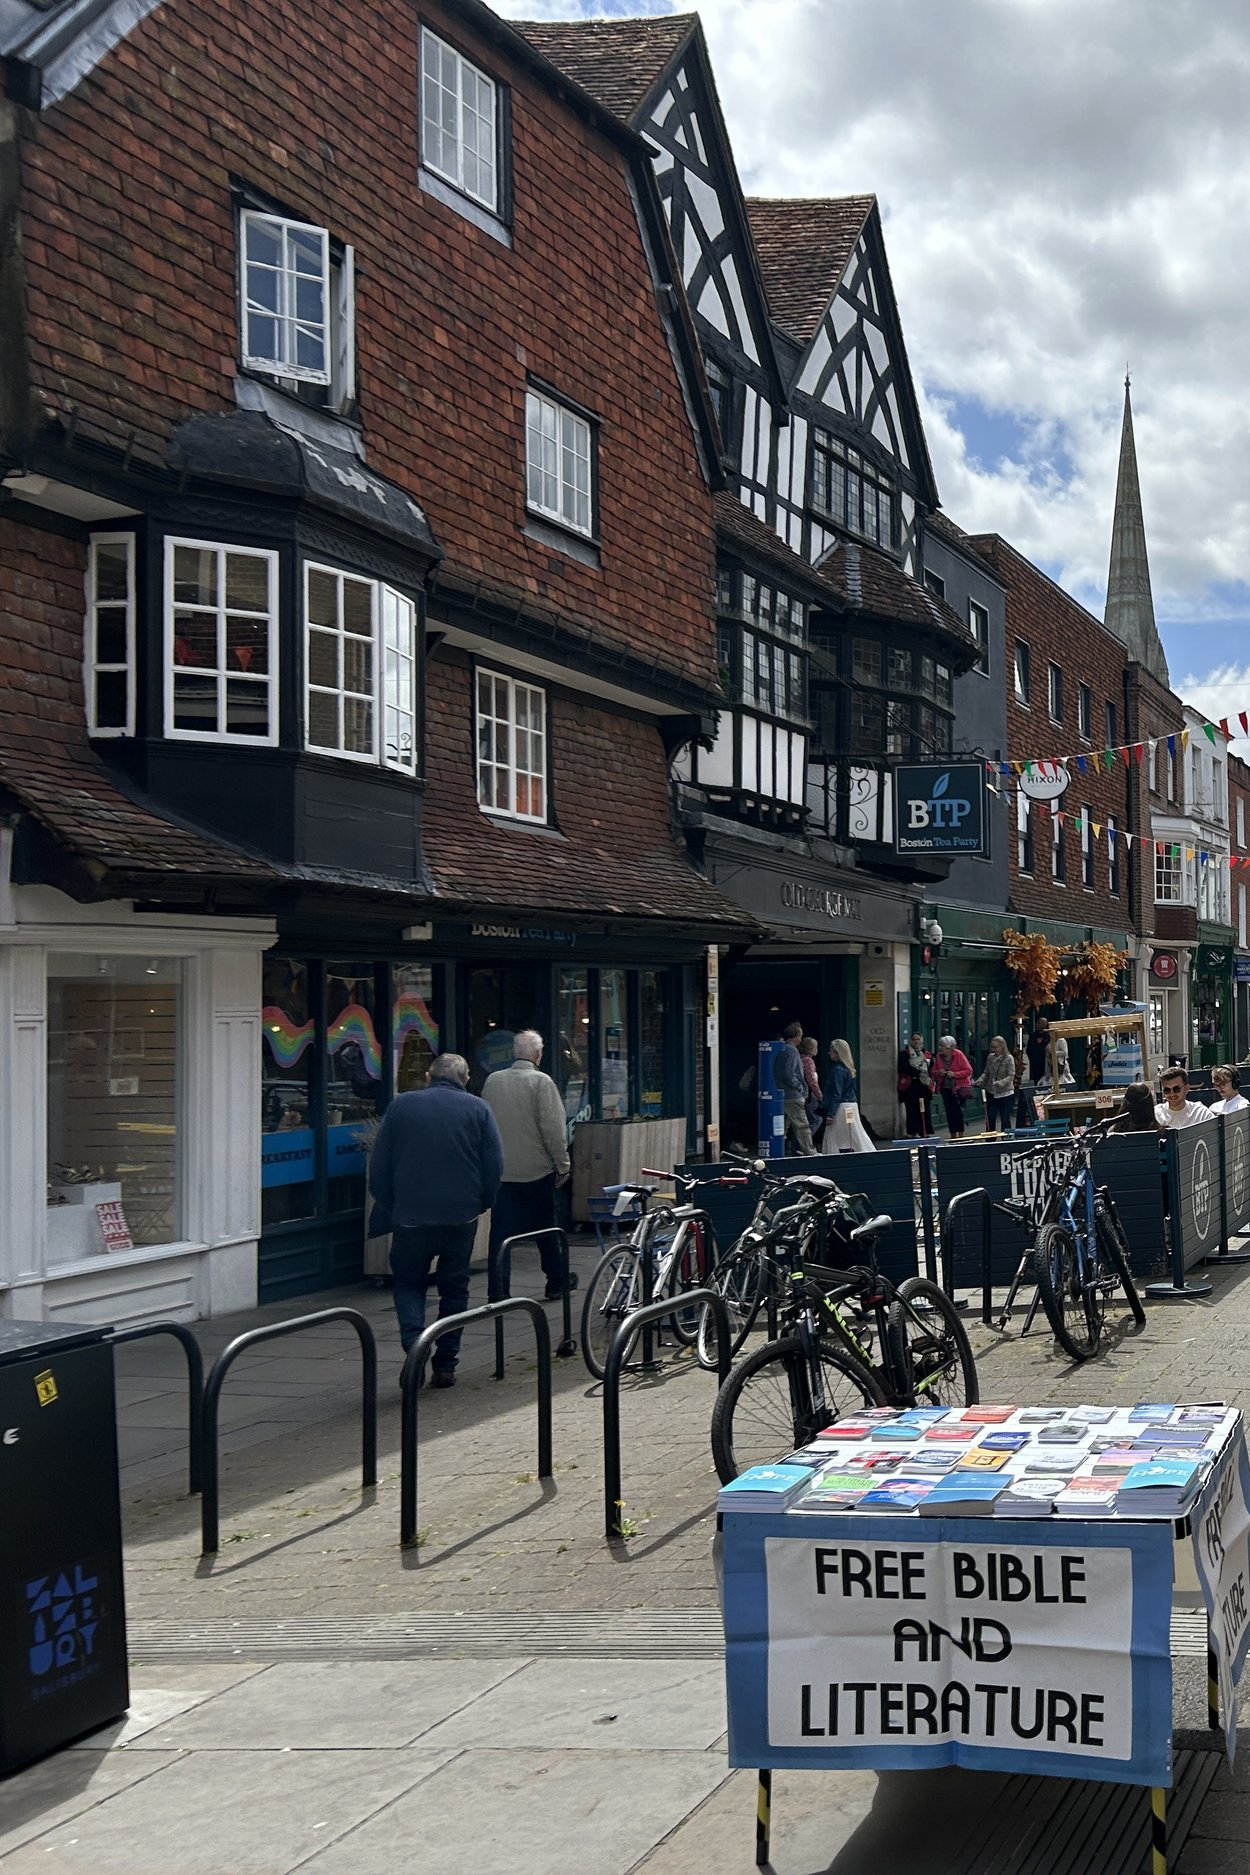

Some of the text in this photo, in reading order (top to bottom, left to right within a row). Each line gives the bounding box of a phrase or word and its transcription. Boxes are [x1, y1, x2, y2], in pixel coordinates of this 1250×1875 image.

[907, 798, 972, 829] BTP
[900, 836, 979, 848] Boston Tea Party
[1097, 1096, 1112, 1104] 306
[96, 1202, 123, 1214] SALE
[98, 1212, 125, 1224] SALE
[101, 1222, 130, 1235] SALE
[1131, 1466, 1188, 1479] HOPE
[814, 1547, 1087, 1604] FREE BIBLE
[892, 1616, 1013, 1663] AND
[801, 1680, 1105, 1747] LITERATURE
